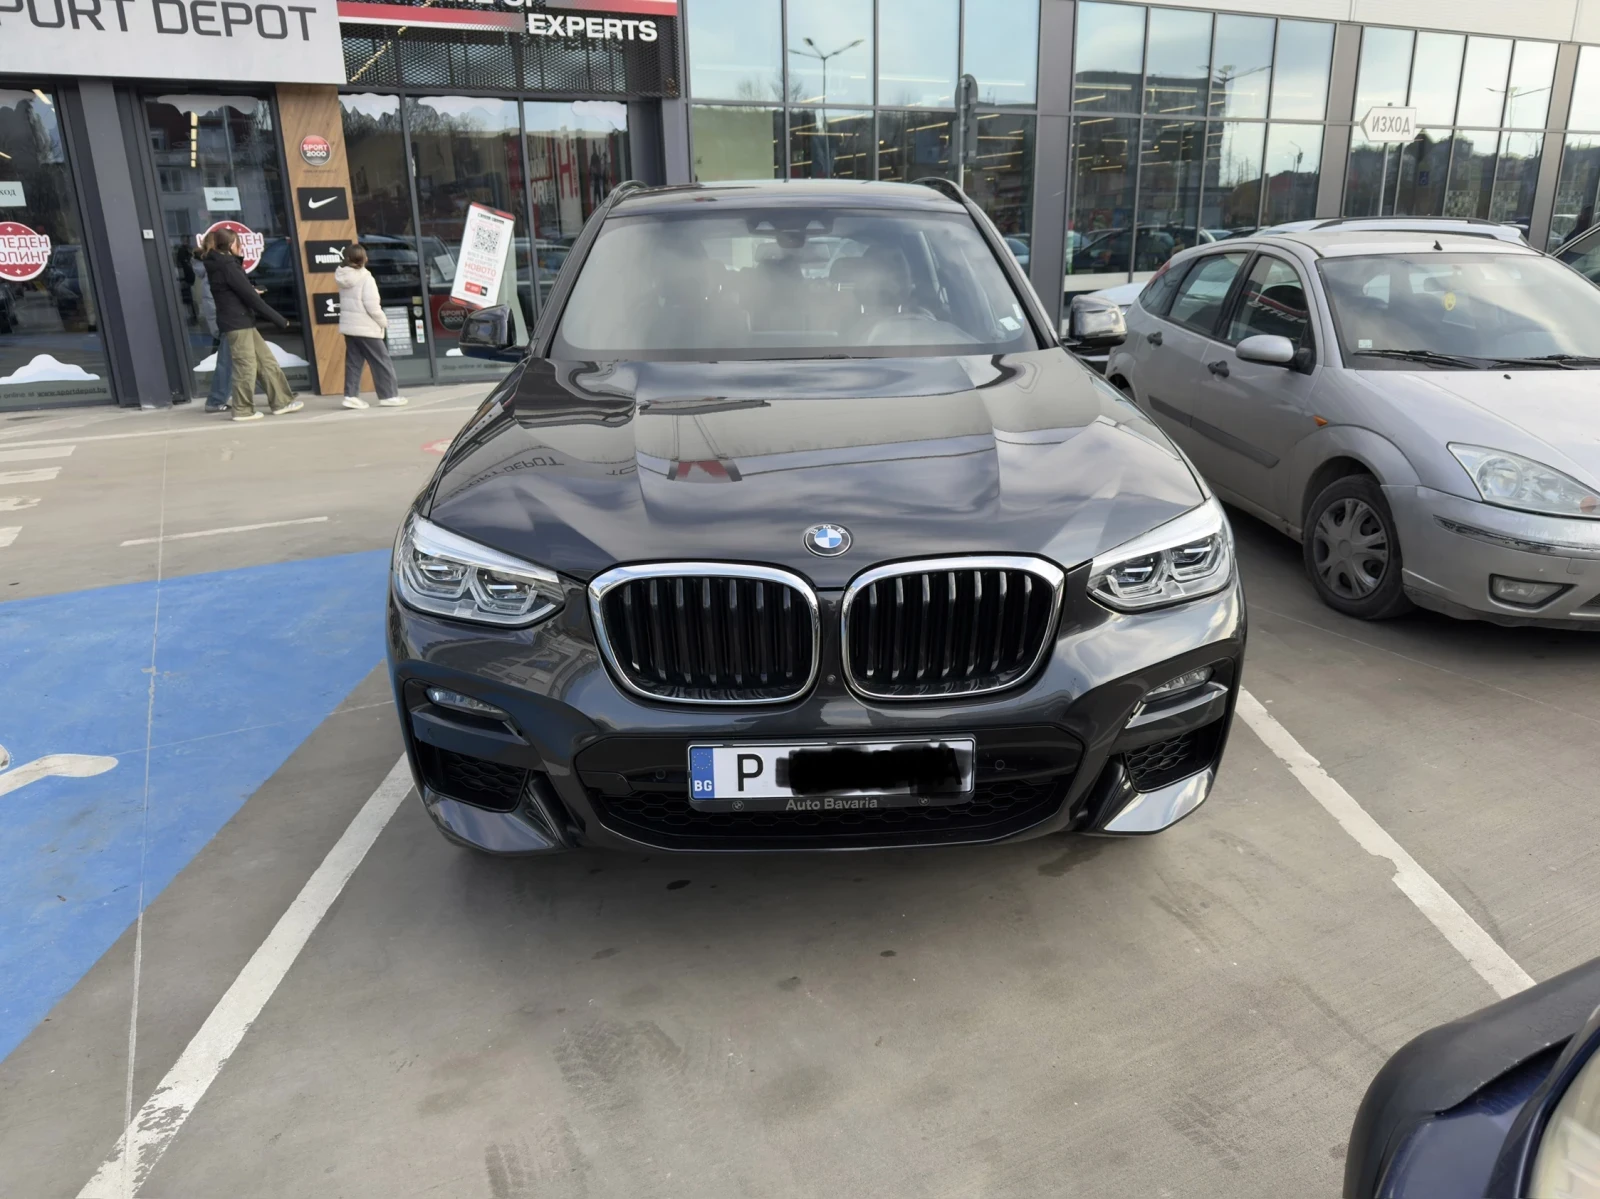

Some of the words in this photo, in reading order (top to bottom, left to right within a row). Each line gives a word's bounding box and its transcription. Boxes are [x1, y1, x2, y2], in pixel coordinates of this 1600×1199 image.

[152, 0, 317, 41] DEPOT
[528, 13, 658, 43] EXPERTS
[1372, 115, 1411, 136] ИЗХОД
[315, 255, 341, 264] PUMA
[810, 524, 847, 535] BMW
[736, 753, 764, 792] P
[693, 780, 713, 792] BG
[785, 799, 821, 811] Auto
[824, 797, 878, 811] Bavaria
